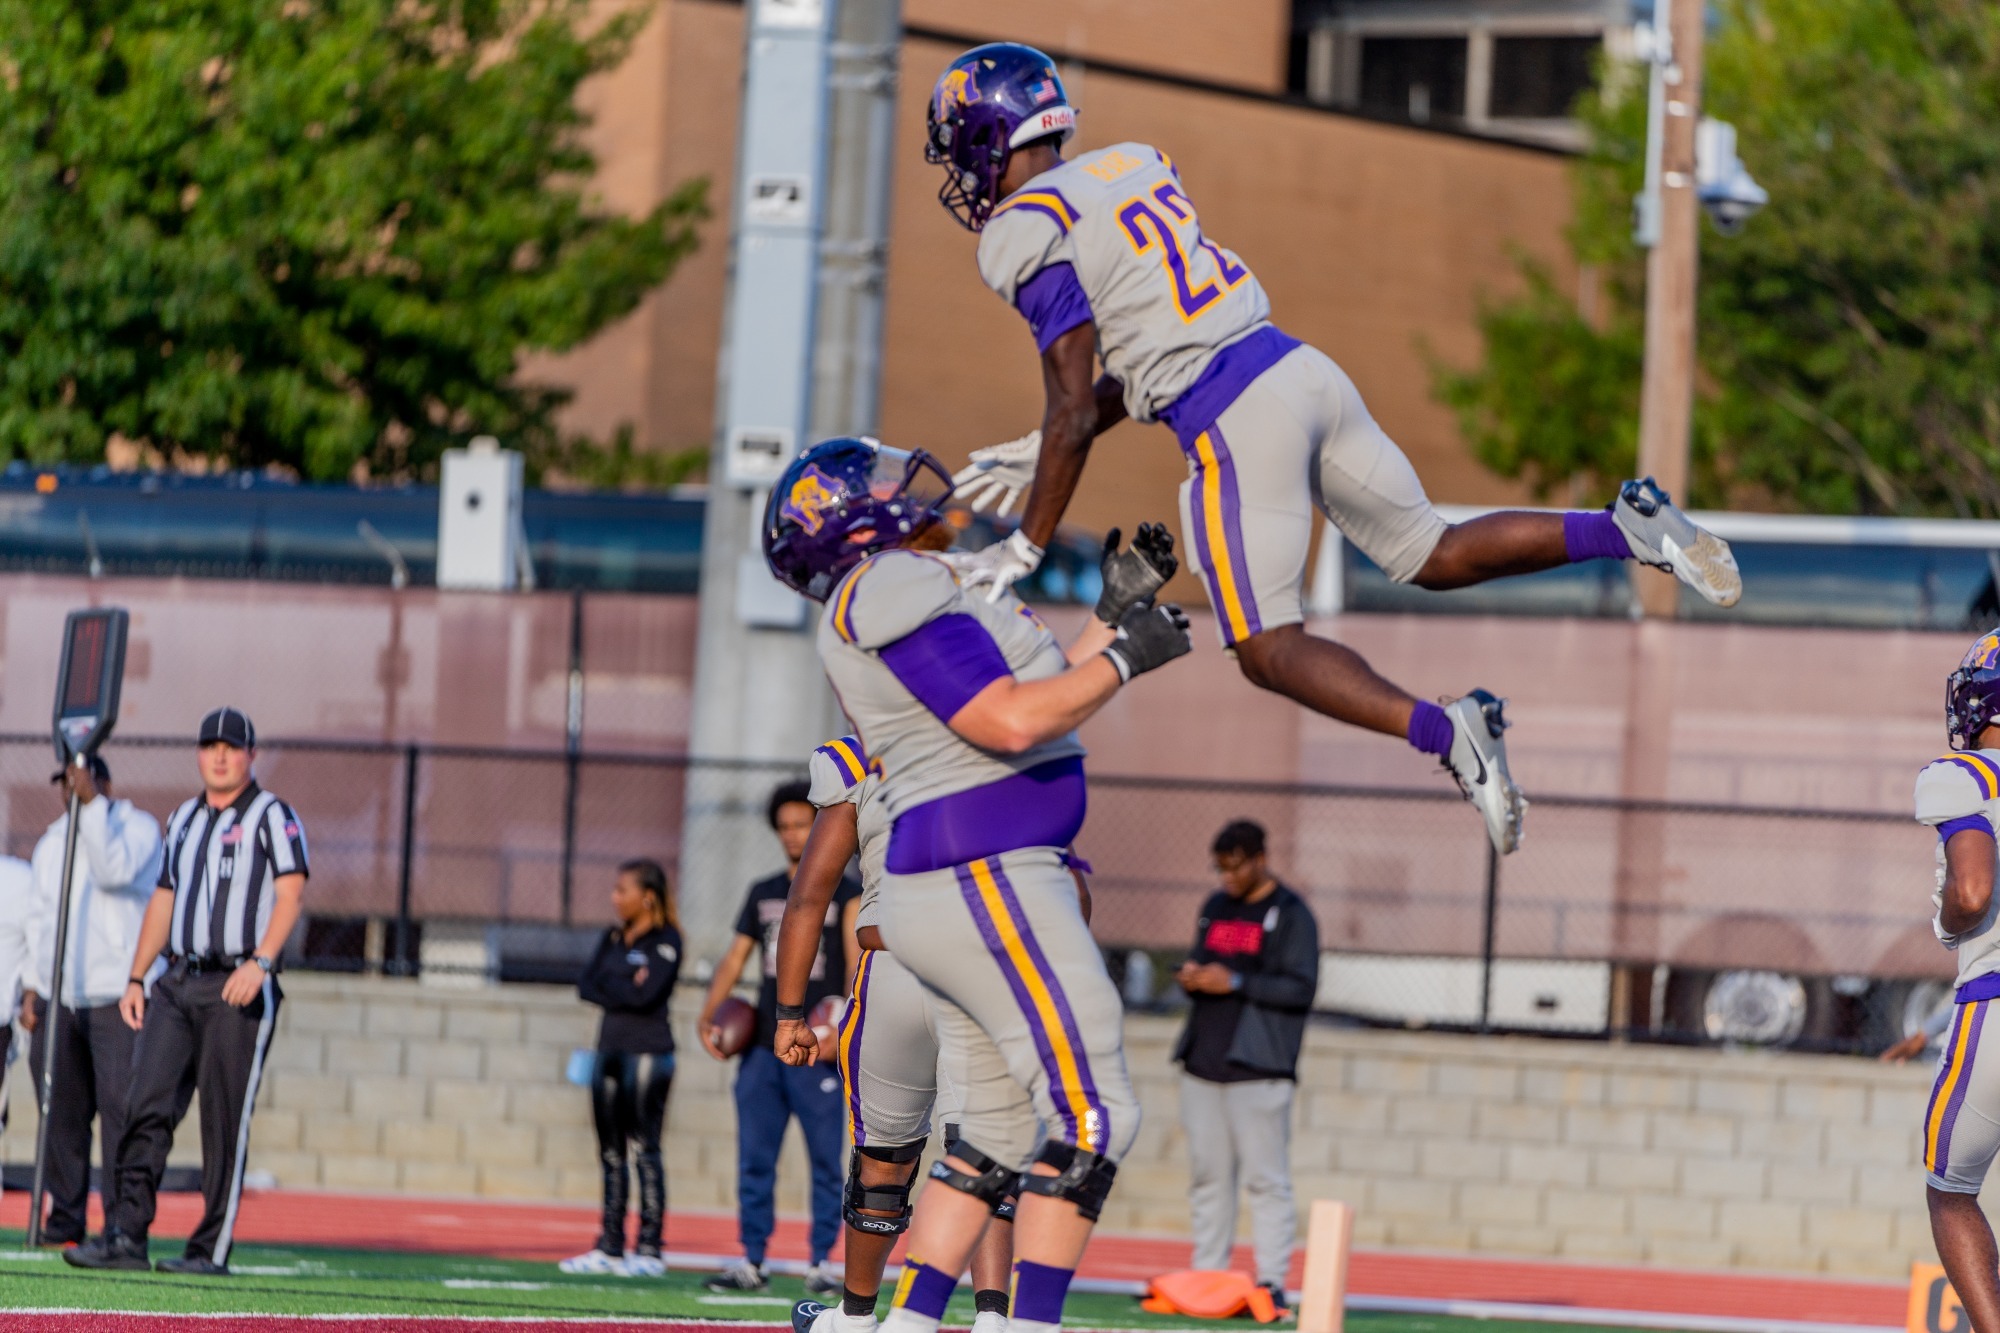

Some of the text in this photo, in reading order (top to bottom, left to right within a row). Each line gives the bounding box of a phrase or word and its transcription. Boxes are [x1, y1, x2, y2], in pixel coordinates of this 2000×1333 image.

[1115, 179, 1251, 324] 22
[862, 1221, 900, 1232] DONJOY
[1926, 1276, 1972, 1333] G
